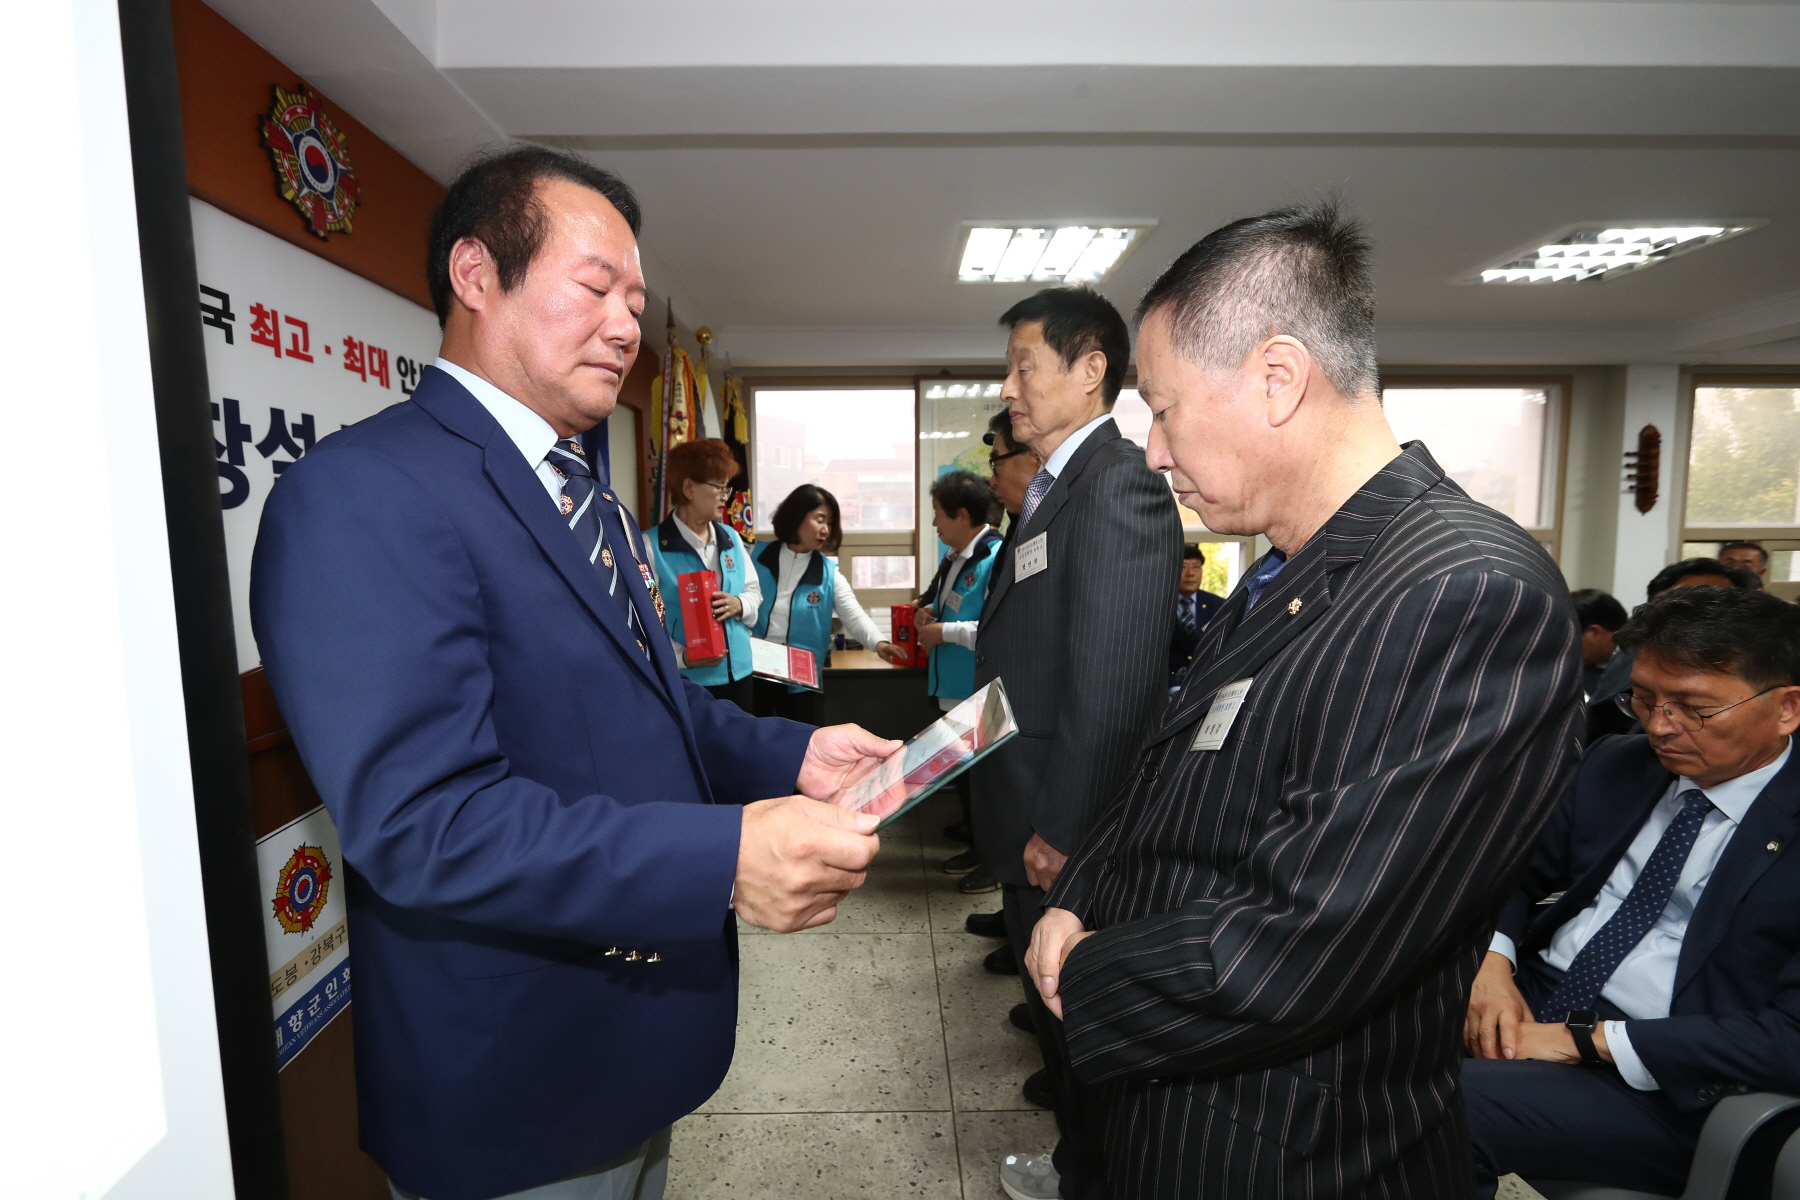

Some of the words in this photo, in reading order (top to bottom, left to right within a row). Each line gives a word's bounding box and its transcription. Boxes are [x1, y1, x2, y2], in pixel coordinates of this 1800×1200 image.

[249, 302, 314, 364] 최고
[342, 335, 391, 390] 최대
[396, 355, 424, 395] 안
